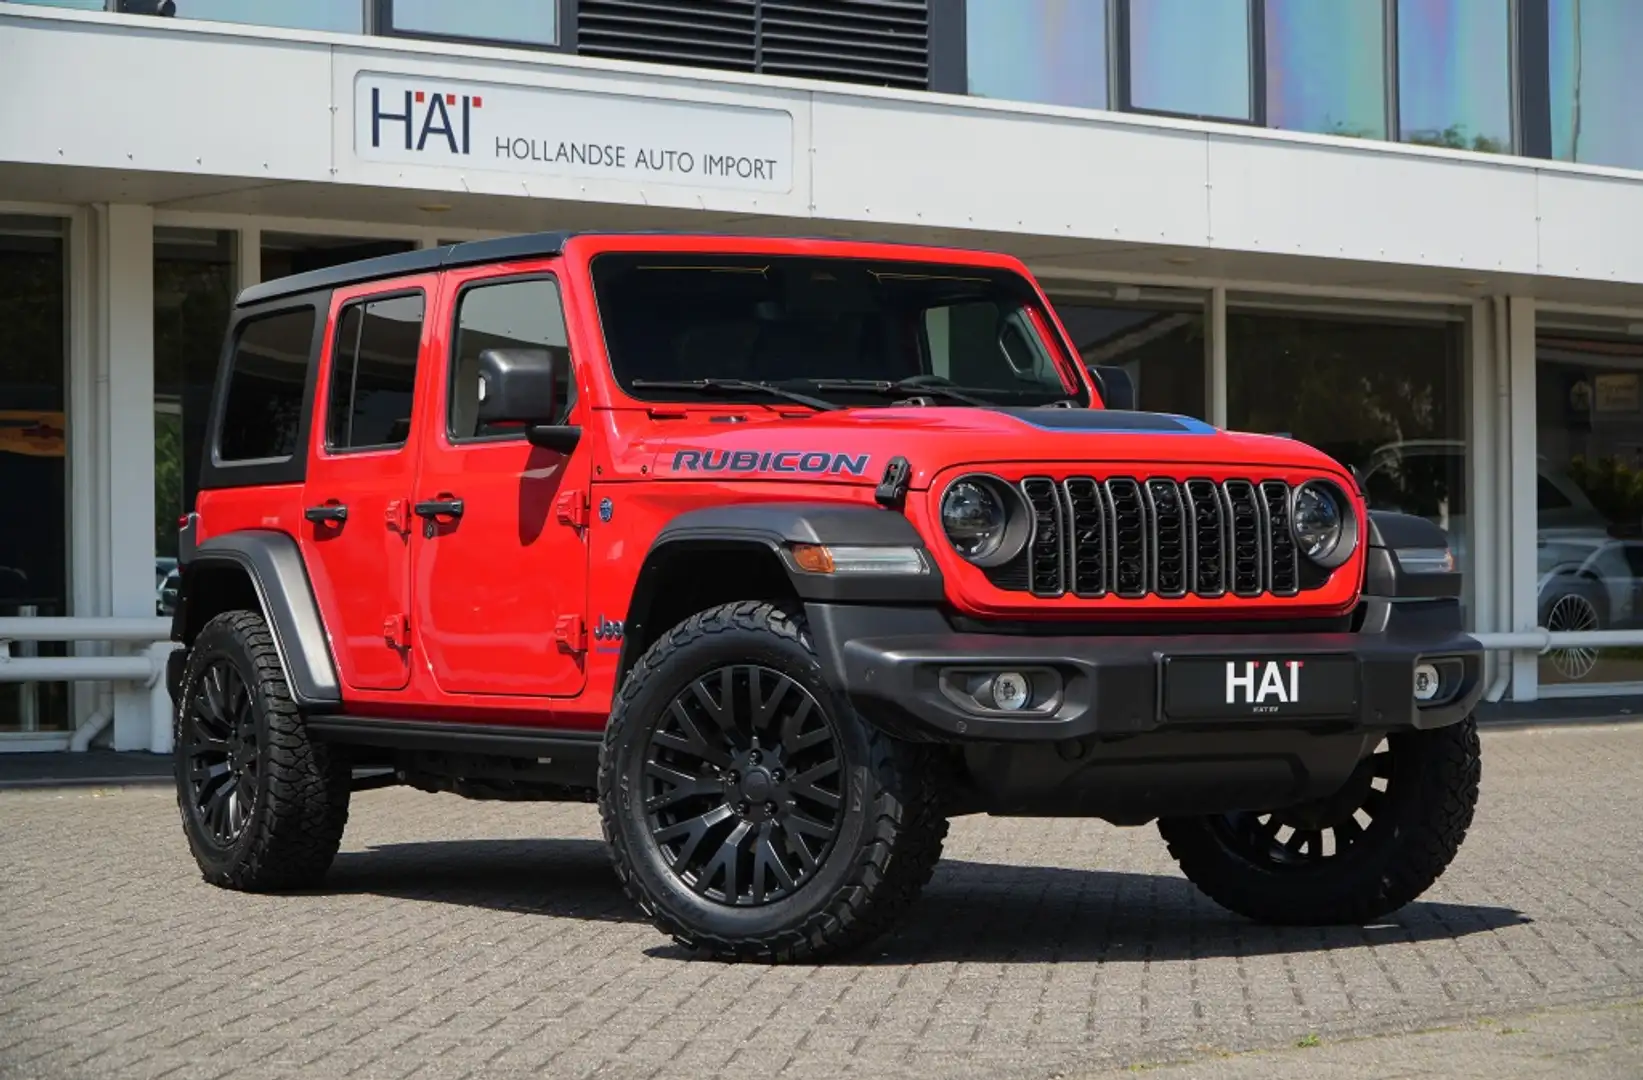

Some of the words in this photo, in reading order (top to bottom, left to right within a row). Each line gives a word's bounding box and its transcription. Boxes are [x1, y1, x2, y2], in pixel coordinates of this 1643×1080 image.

[495, 136, 625, 168] HOLLANDSE
[635, 149, 694, 173] AUTO
[703, 154, 777, 180] IMPORT
[672, 450, 870, 475] RUBICON
[594, 614, 625, 638] Jee
